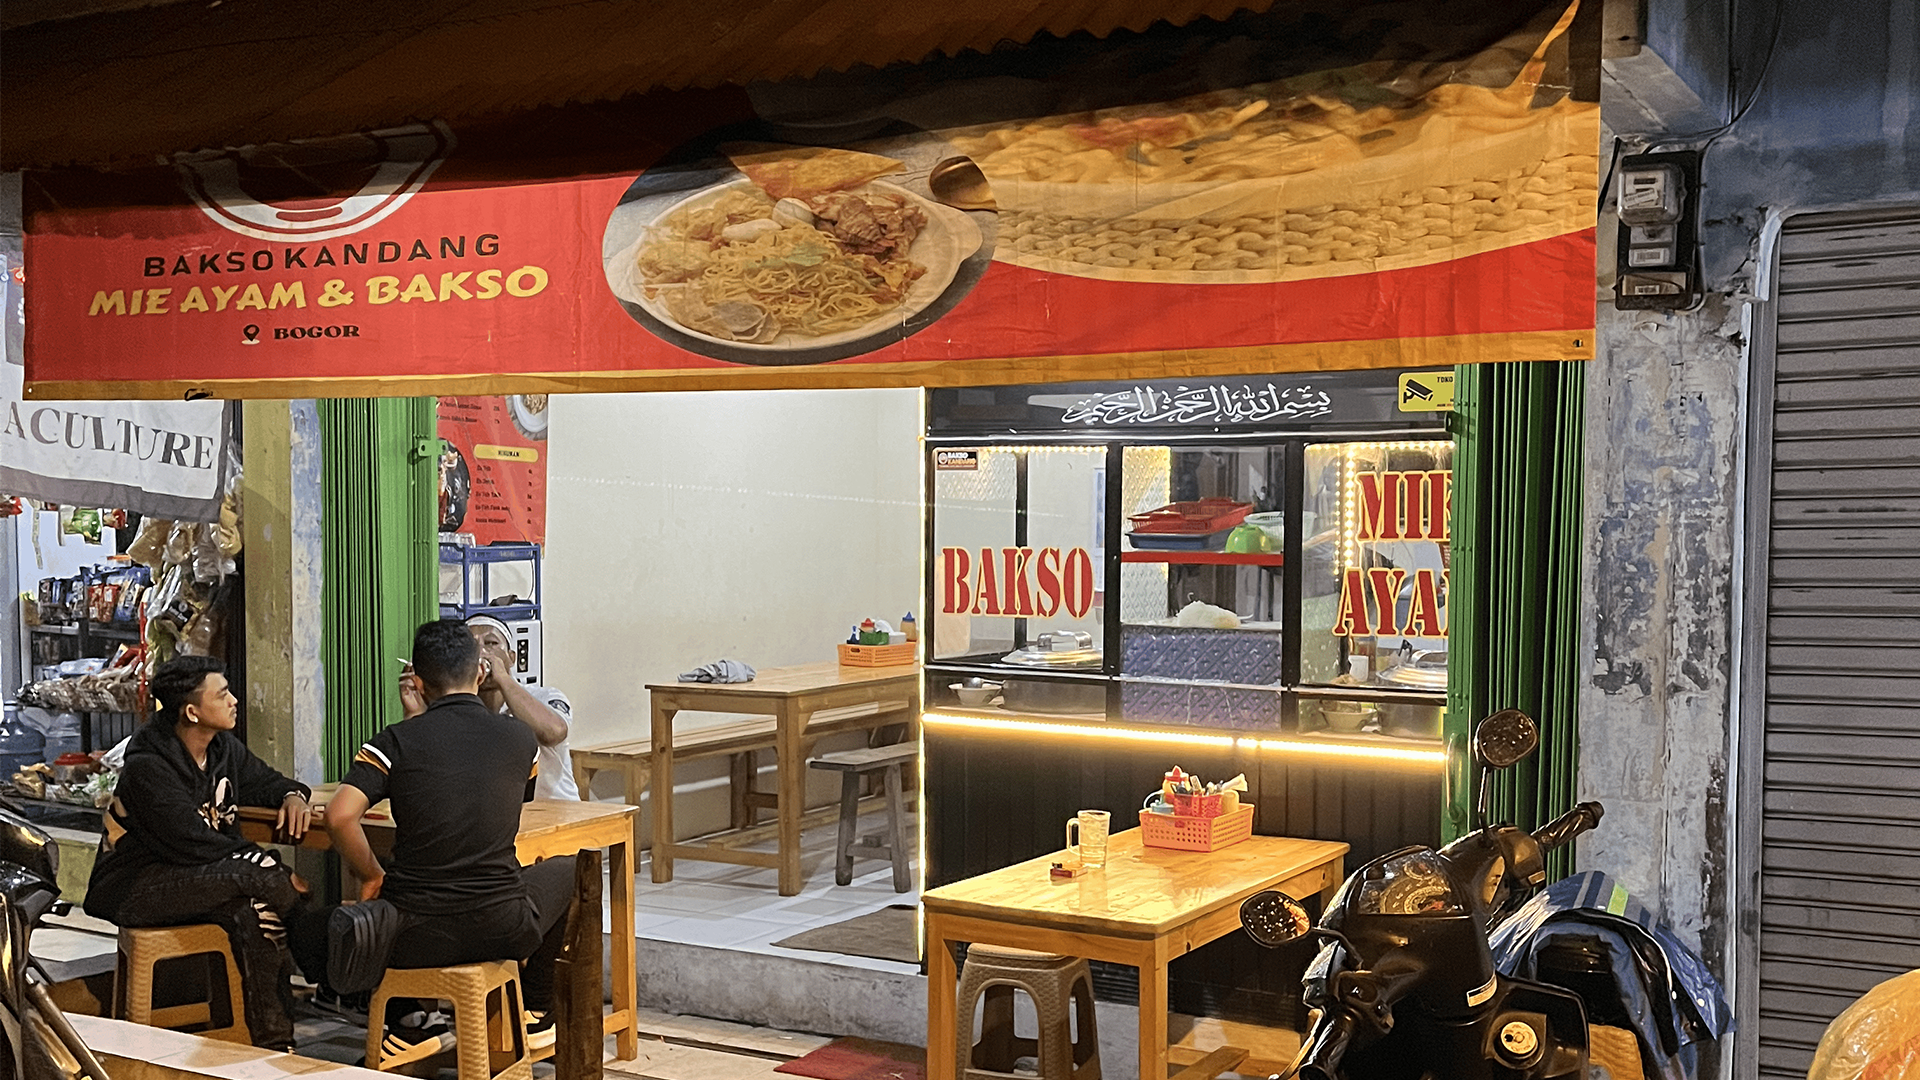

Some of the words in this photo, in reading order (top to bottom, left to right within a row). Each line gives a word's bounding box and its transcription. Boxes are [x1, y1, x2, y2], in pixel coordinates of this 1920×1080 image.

[88, 287, 172, 317] MIE
[179, 280, 307, 313] AYAM
[317, 278, 355, 307] &
[365, 265, 549, 304] BAKSO
[273, 324, 360, 341] BOGOR
[0, 396, 214, 470] ACULTURE
[942, 547, 1094, 619] BAKSO
[1332, 568, 1451, 638] AYA
